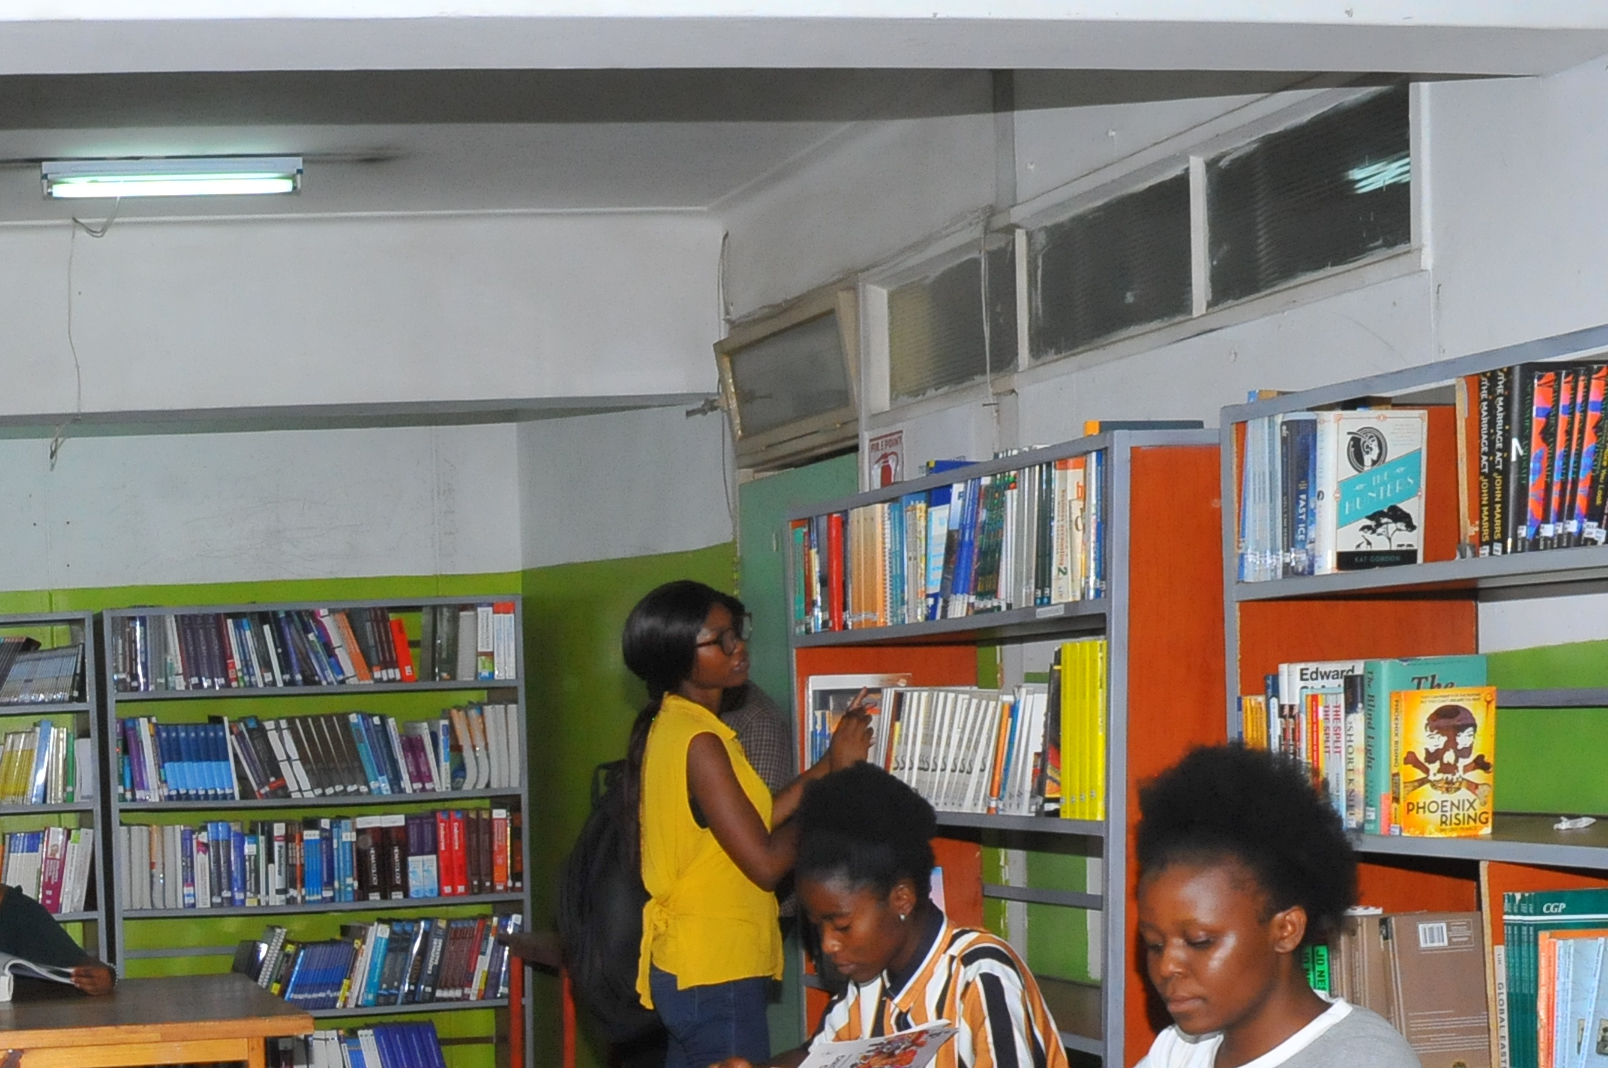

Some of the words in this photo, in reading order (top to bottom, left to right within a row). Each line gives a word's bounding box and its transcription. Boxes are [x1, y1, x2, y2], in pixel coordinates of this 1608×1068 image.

[1480, 376, 1490, 400] THE
[1495, 371, 1505, 395] THE
[1480, 401, 1489, 456] MARRIAGE
[1495, 396, 1504, 450] MARRIAGE
[1480, 457, 1489, 474] ACT
[1495, 450, 1503, 471] ACT
[1372, 471, 1389, 486] THE
[1480, 476, 1489, 504] JOHN
[1494, 473, 1502, 502] JOHN
[1298, 494, 1307, 520] FAST
[1345, 476, 1414, 515] HUNTERS
[1596, 485, 1604, 506] Look
[1297, 523, 1306, 541] ICE
[1481, 505, 1490, 542] MARRS
[1493, 503, 1502, 540] MARRS
[1369, 554, 1401, 563] GORDON
[1057, 566, 1068, 577] 2
[1299, 665, 1355, 682] Edward
[1412, 674, 1456, 690] The
[1333, 704, 1341, 725] THE
[1366, 694, 1375, 730] Blind
[1333, 726, 1341, 755] SPLIT
[1346, 725, 1355, 772] SHORT
[1406, 798, 1477, 815] PHOENIX
[1440, 811, 1489, 826] RISING
[1542, 902, 1566, 914] CGP
[1497, 981, 1505, 1034] GLOBAL
